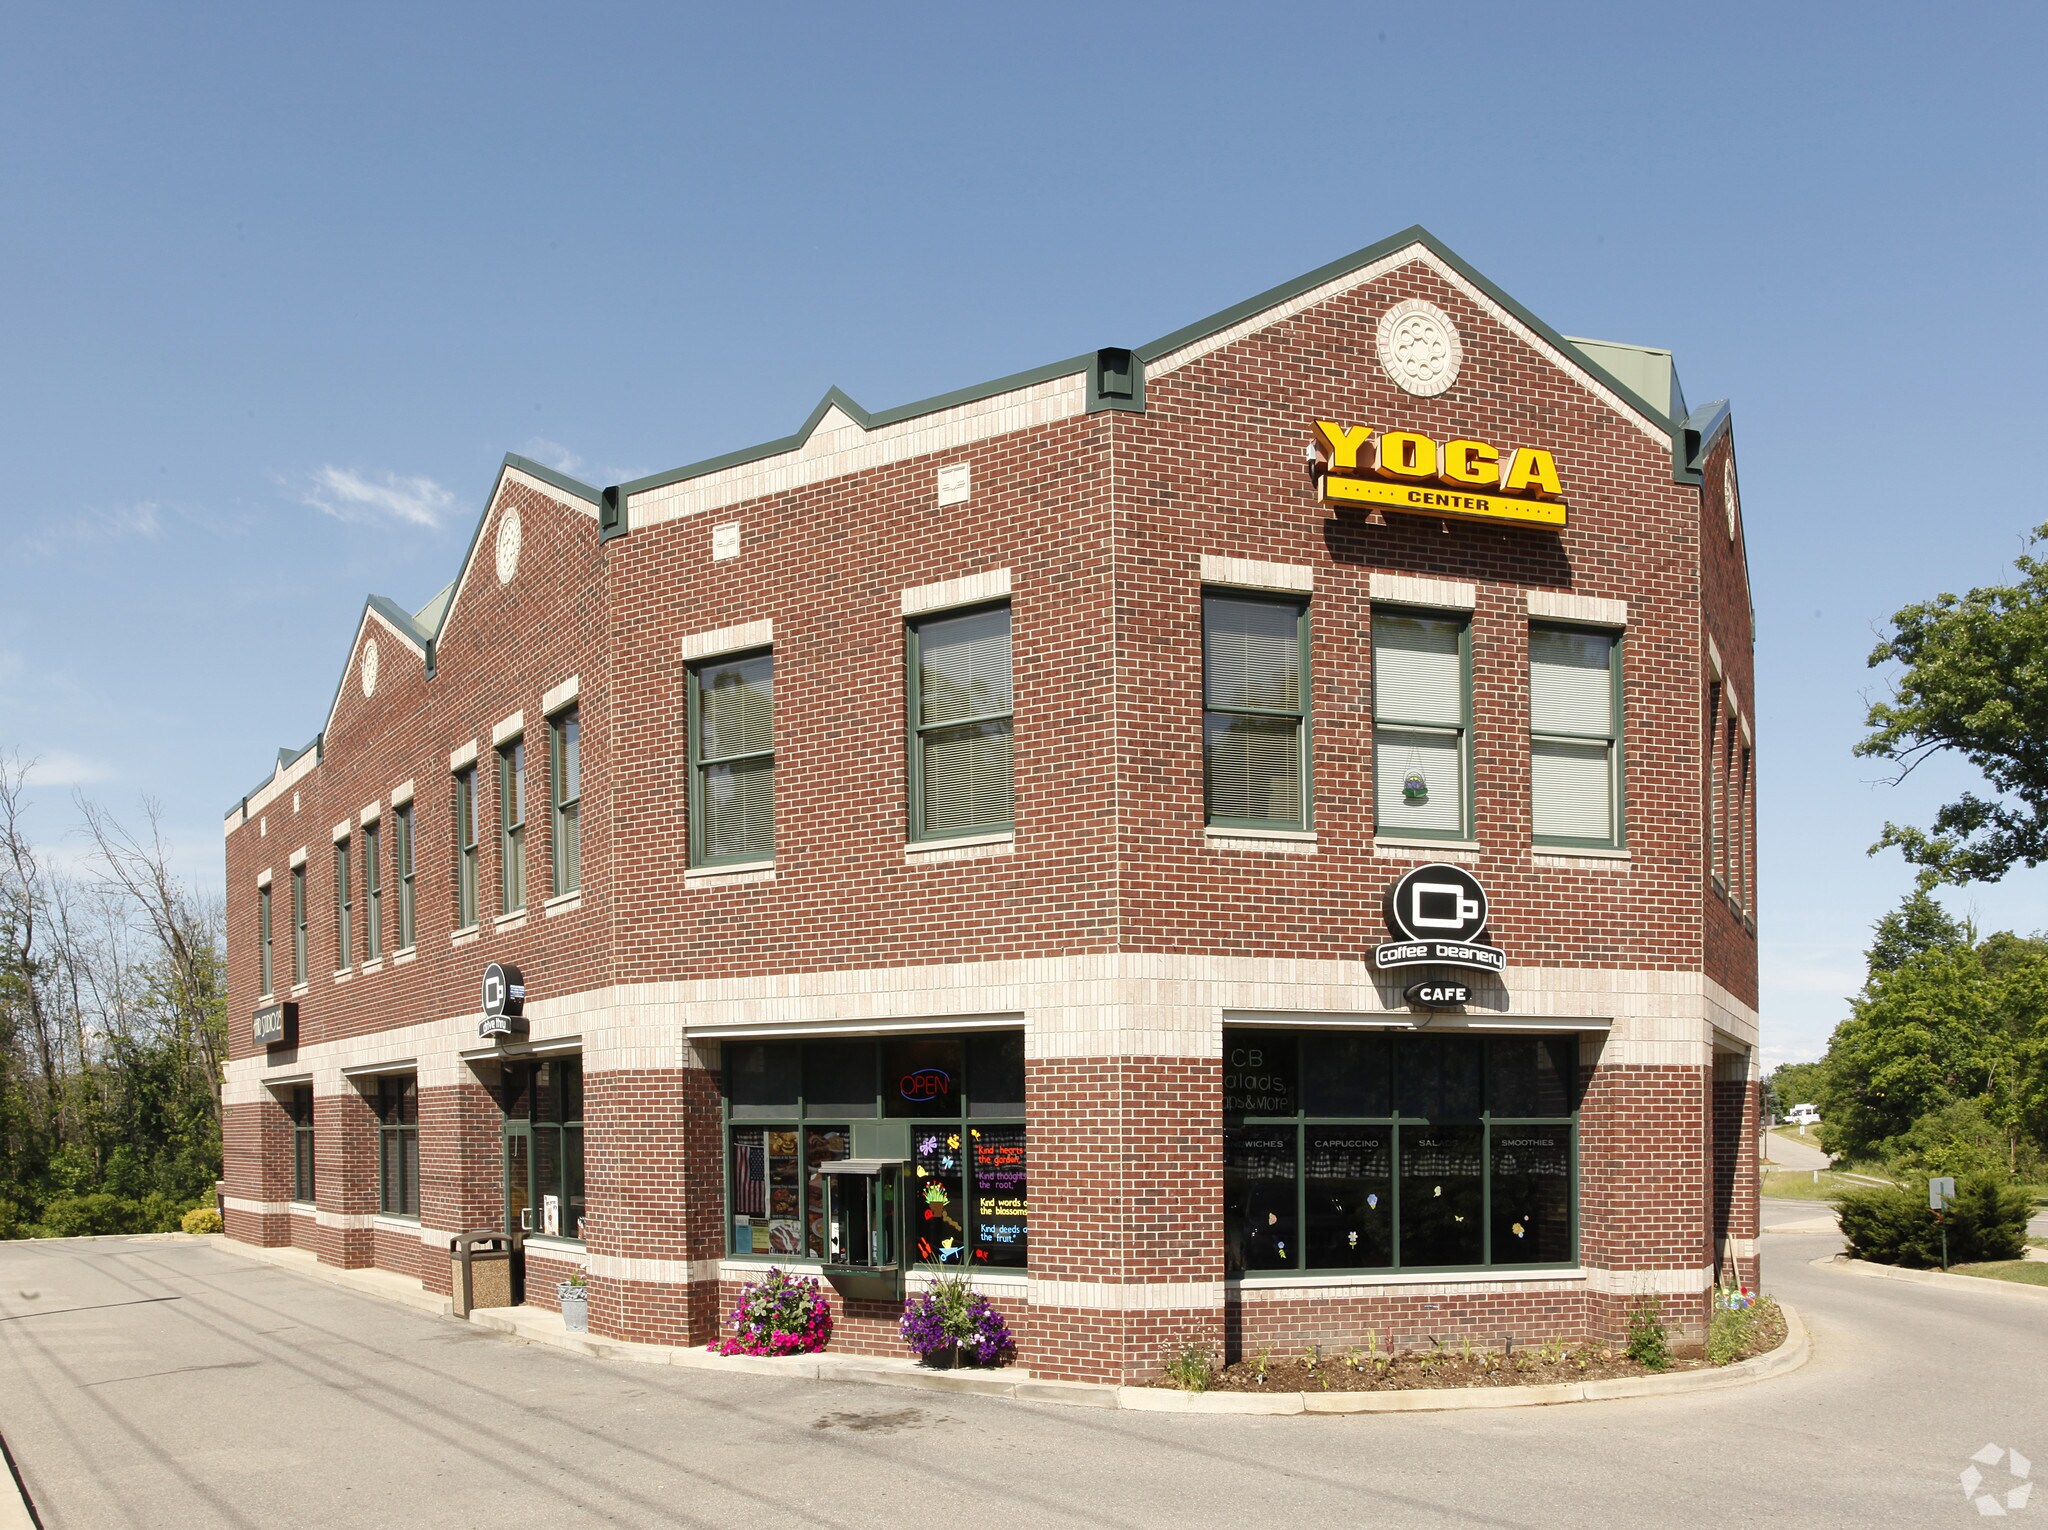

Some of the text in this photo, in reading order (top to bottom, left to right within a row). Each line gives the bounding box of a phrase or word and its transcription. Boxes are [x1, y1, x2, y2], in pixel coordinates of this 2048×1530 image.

[1313, 420, 1563, 495] YOGA
[1407, 490, 1490, 511] CENTER
[1379, 944, 1503, 969] coffee beanery
[1419, 987, 1466, 1001] CAFE
[483, 1020, 496, 1032] drive
[1231, 1048, 1263, 1068] CB
[900, 1075, 948, 1095] OPEN
[1224, 1073, 1287, 1095] alads,
[1314, 1139, 1379, 1148] CAPPUCCINO
[1501, 1138, 1555, 1147] SMOOTHIES
[999, 1146, 1023, 1154] hearts
[978, 1155, 991, 1163] the
[979, 1171, 1026, 1183] Kind thoughts
[979, 1180, 991, 1189] the
[980, 1197, 995, 1207] Kind
[998, 1197, 1021, 1207] words
[980, 1206, 1028, 1216] the blossoms
[981, 1224, 996, 1233] Kind
[999, 1224, 1021, 1234] deeds
[980, 1232, 993, 1242] the
